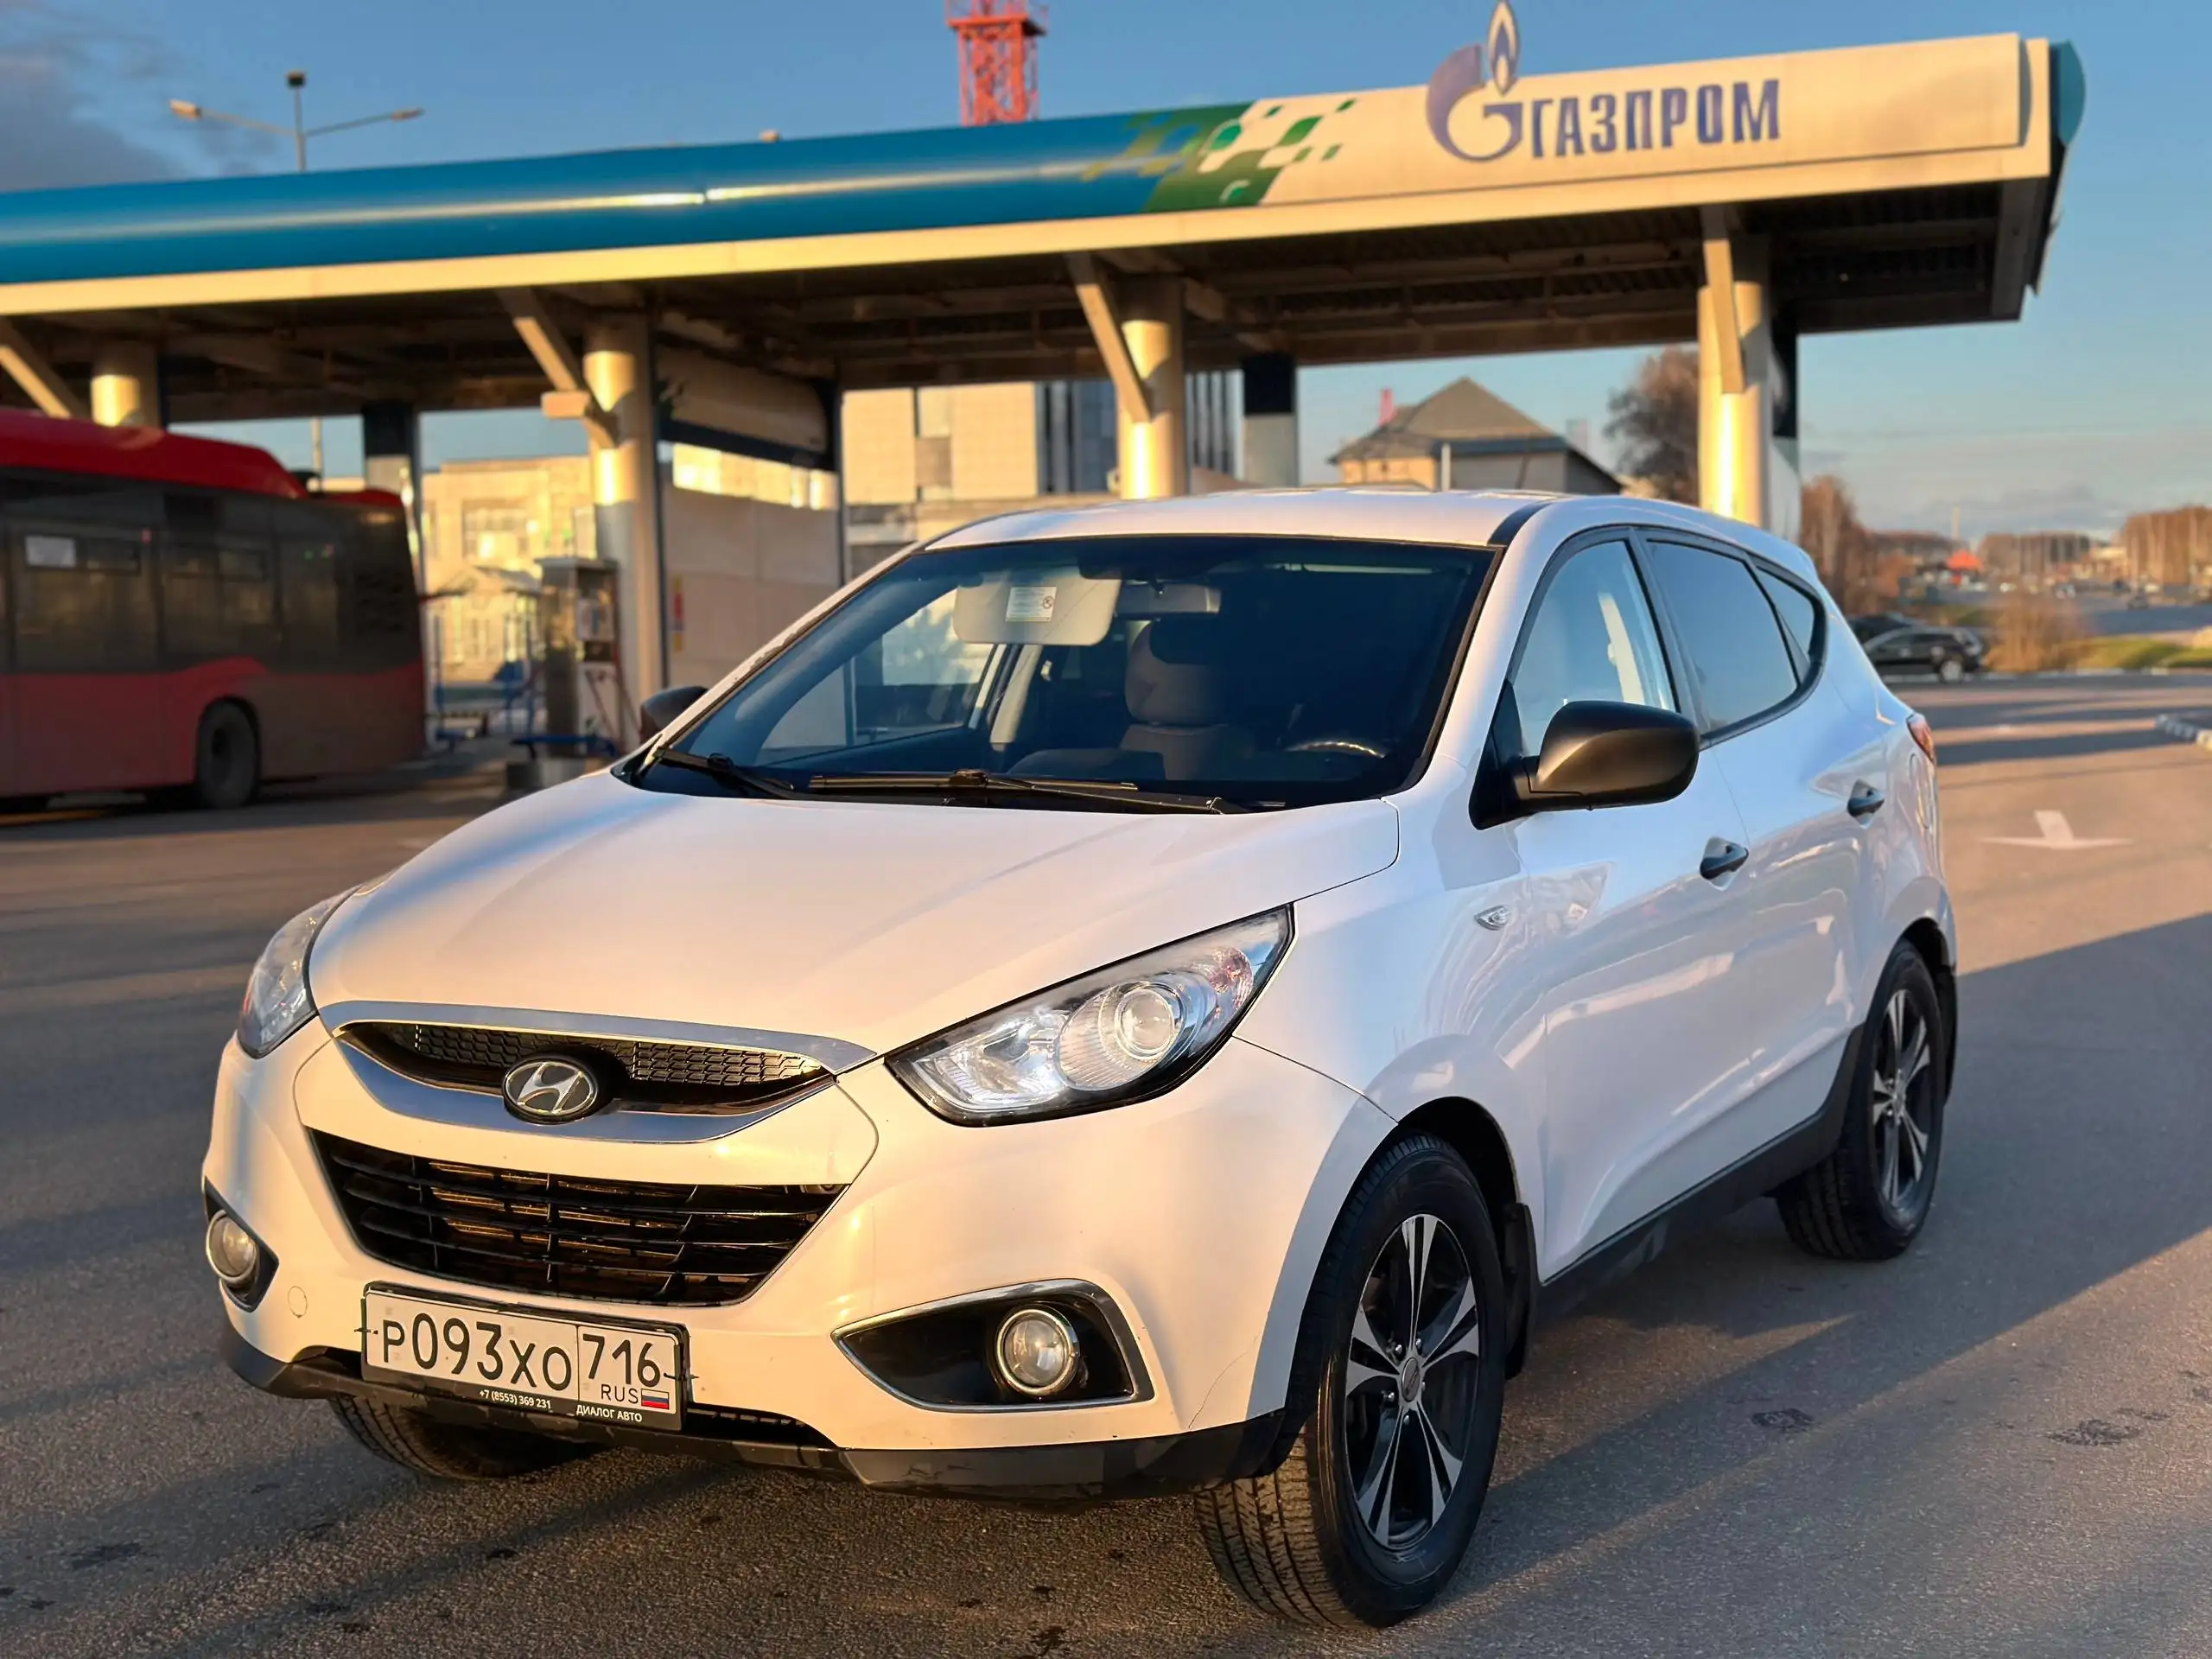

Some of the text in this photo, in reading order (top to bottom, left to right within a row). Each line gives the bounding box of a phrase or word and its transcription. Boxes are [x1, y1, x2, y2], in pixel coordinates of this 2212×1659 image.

[1531, 79, 1780, 159] ГАЗПРОМ
[582, 1333, 661, 1388] 716
[480, 1389, 552, 1410] +7 (8553) 369 231
[601, 1383, 639, 1404] RUS
[575, 1404, 644, 1423] ДИАЛОГ АВТО
